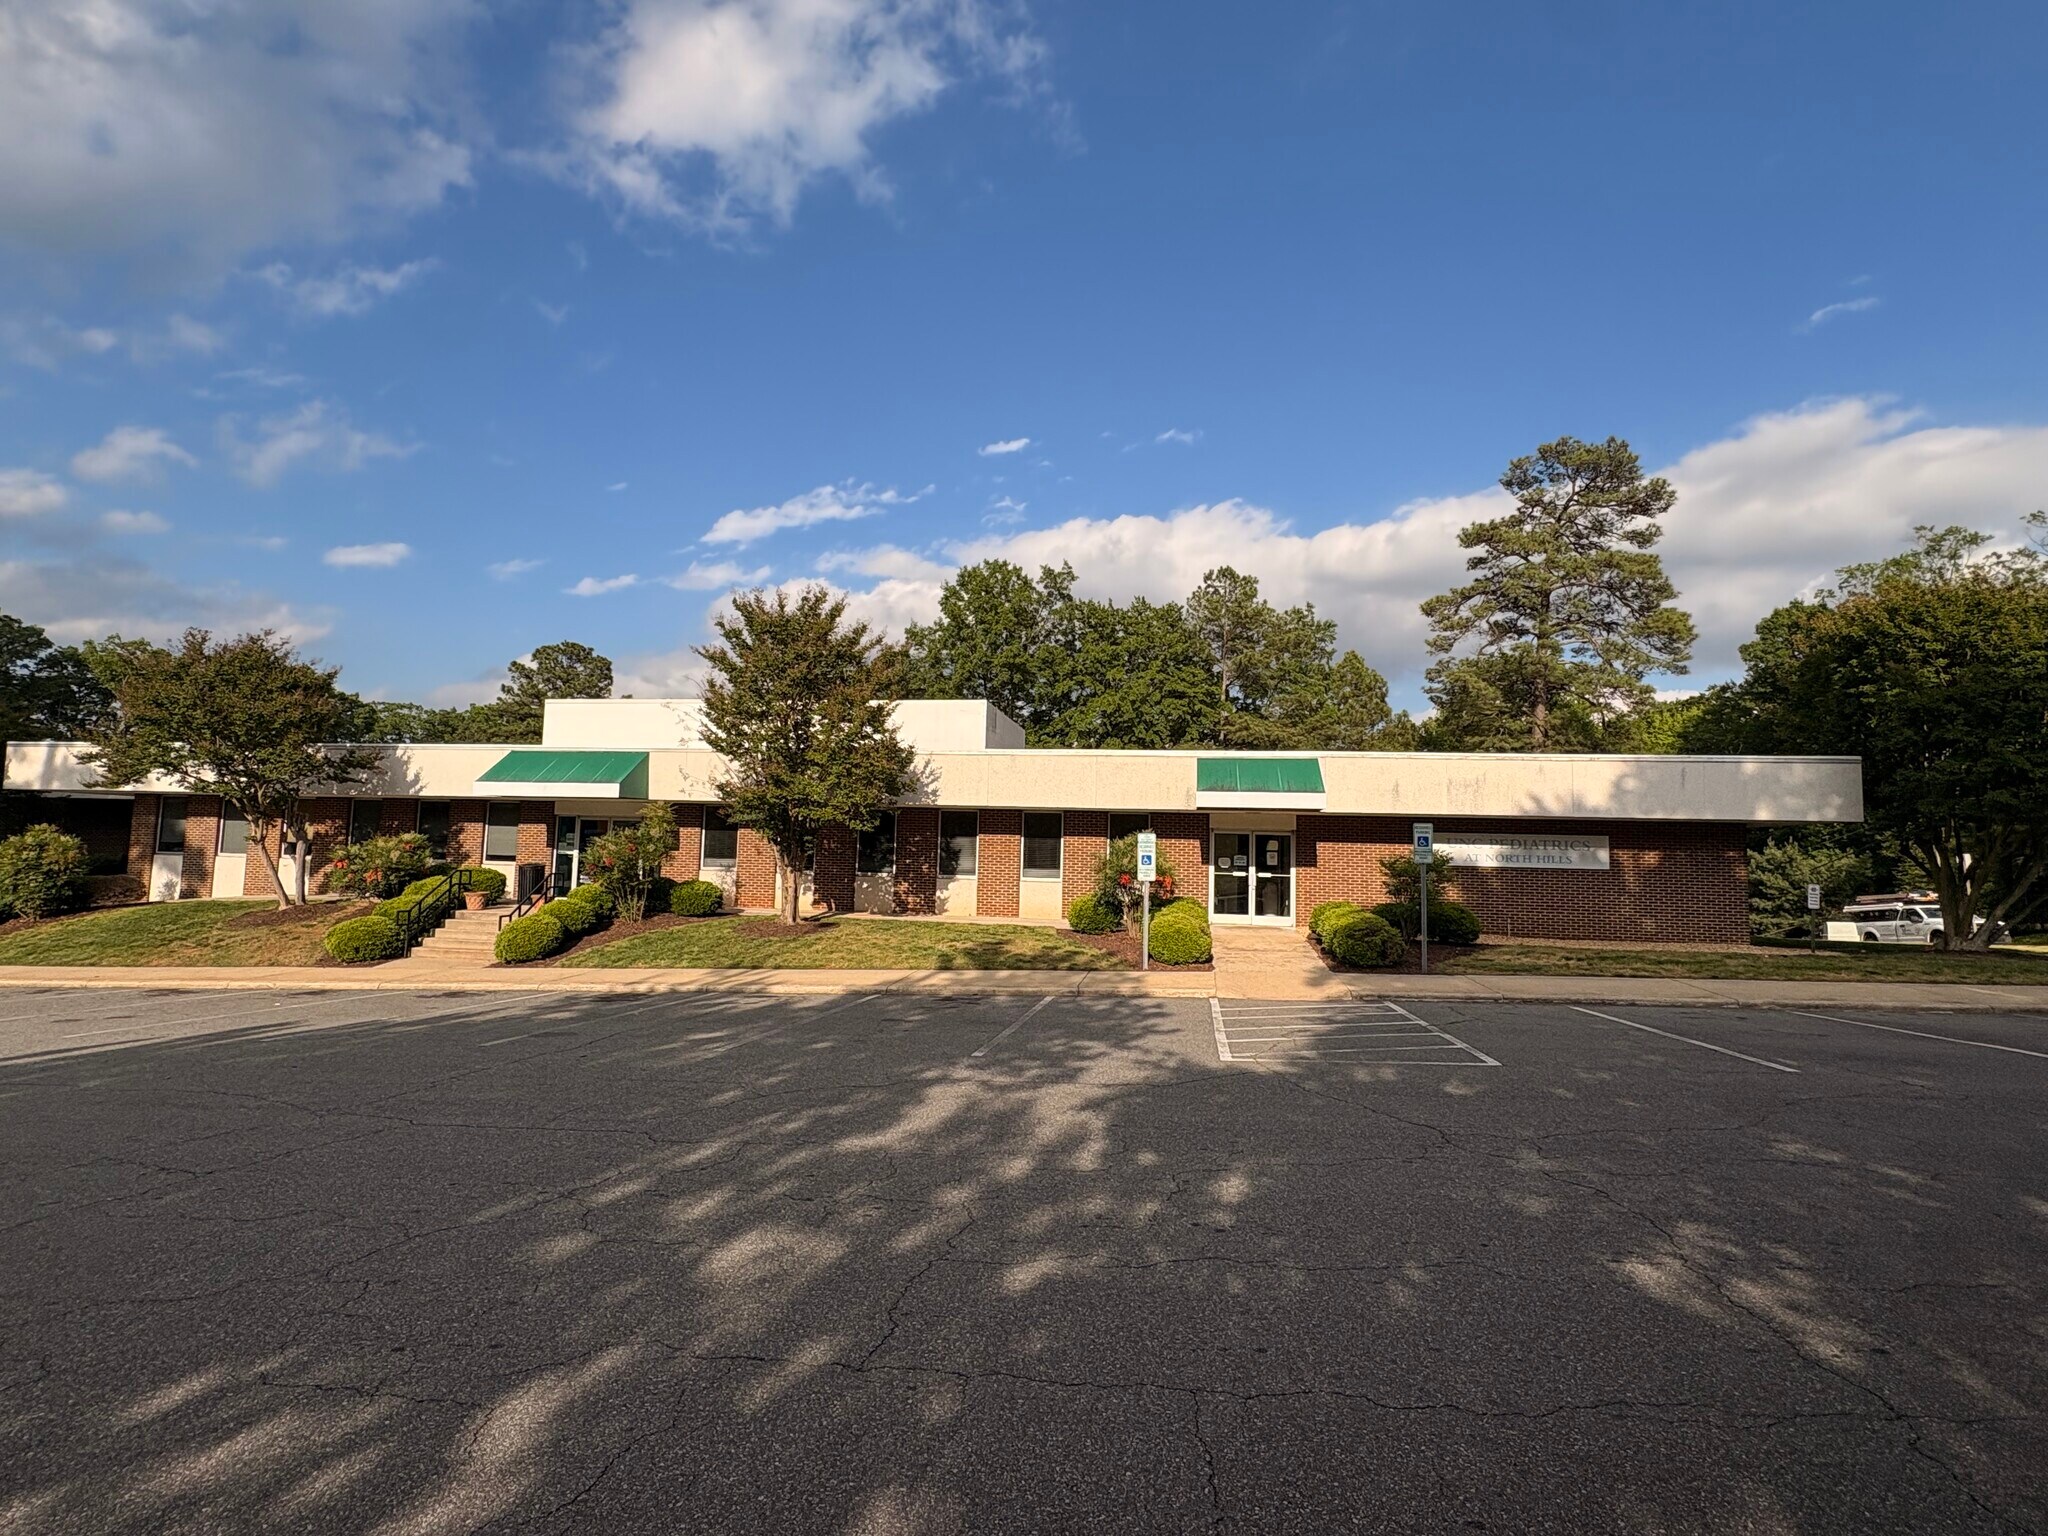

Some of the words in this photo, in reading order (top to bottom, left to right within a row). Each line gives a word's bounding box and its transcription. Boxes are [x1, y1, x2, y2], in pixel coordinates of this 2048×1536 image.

[1446, 838, 1484, 850] UNC
[1489, 838, 1591, 851] PEDIATRICS
[1465, 853, 1481, 862] AT
[1485, 854, 1532, 863] NORTH
[1536, 855, 1573, 864] HILLS
